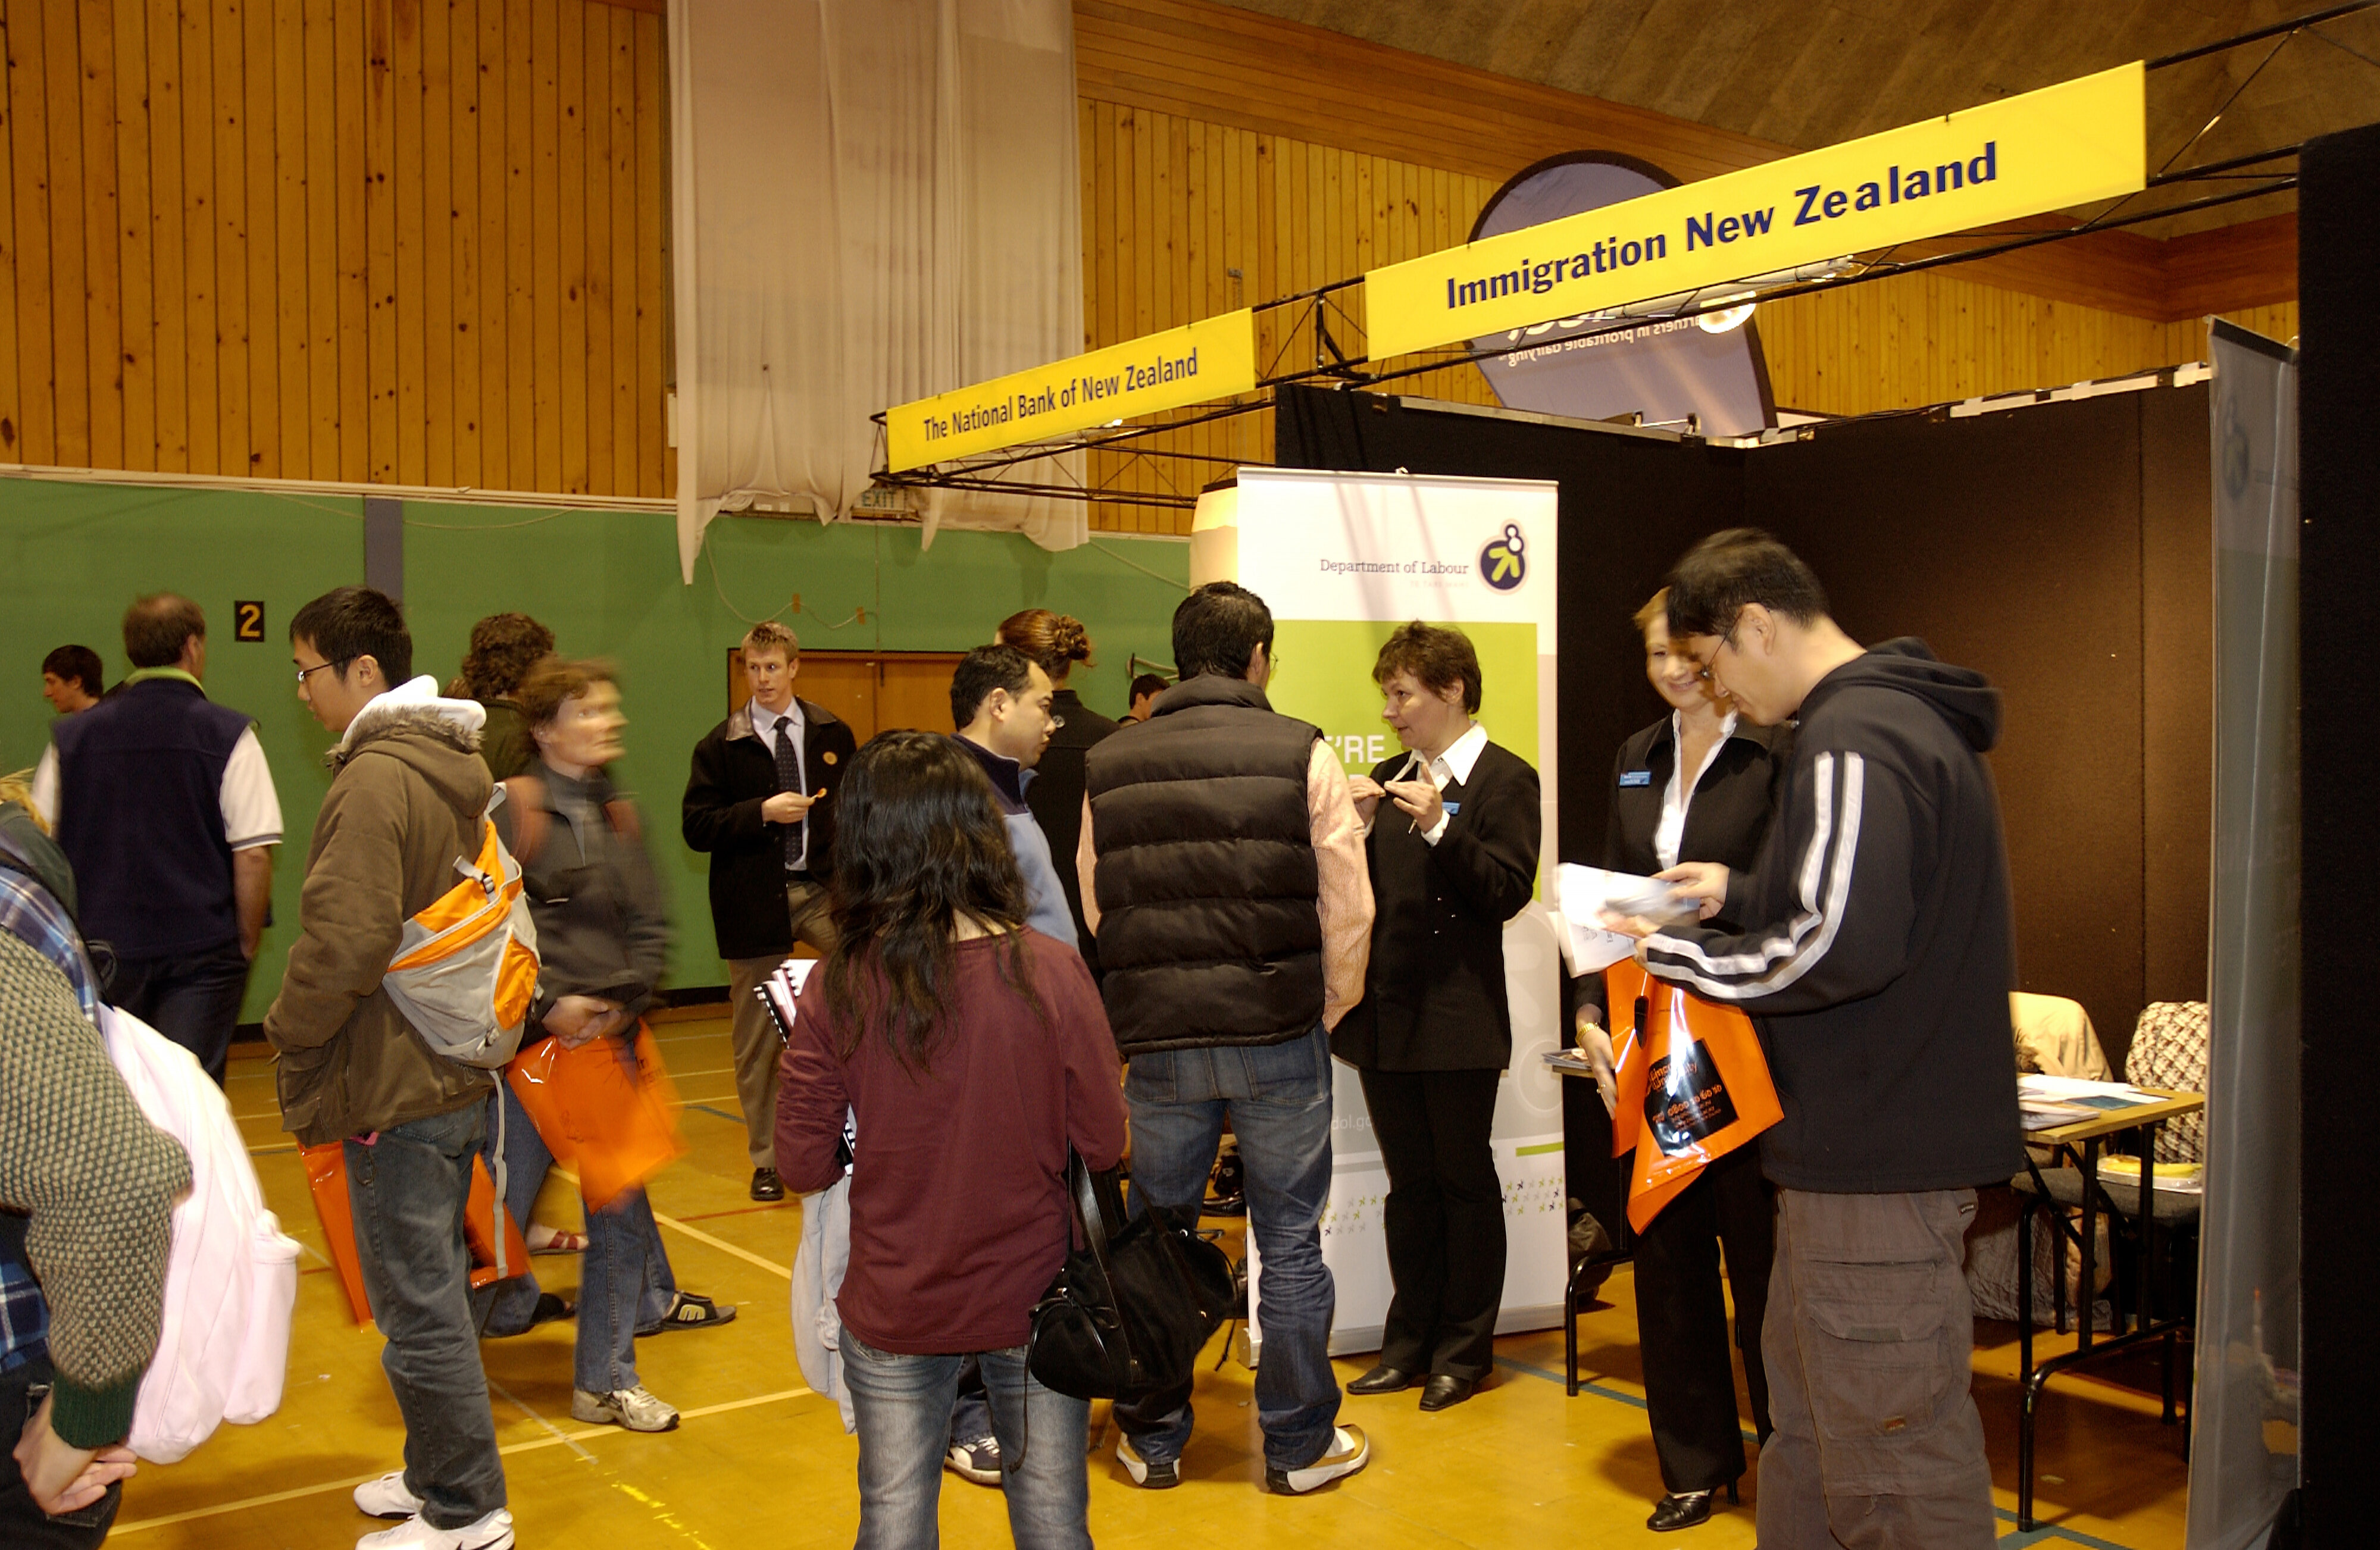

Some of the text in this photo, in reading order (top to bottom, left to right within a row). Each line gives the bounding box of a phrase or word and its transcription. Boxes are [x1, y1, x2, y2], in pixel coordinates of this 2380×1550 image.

[1447, 142, 1997, 309] Immigration New Zealand
[924, 347, 1198, 441] The National Bank of New Zealand
[1321, 560, 1469, 574] Department of Labour
[240, 604, 261, 637] 2
[1325, 735, 1384, 763] 'RE
